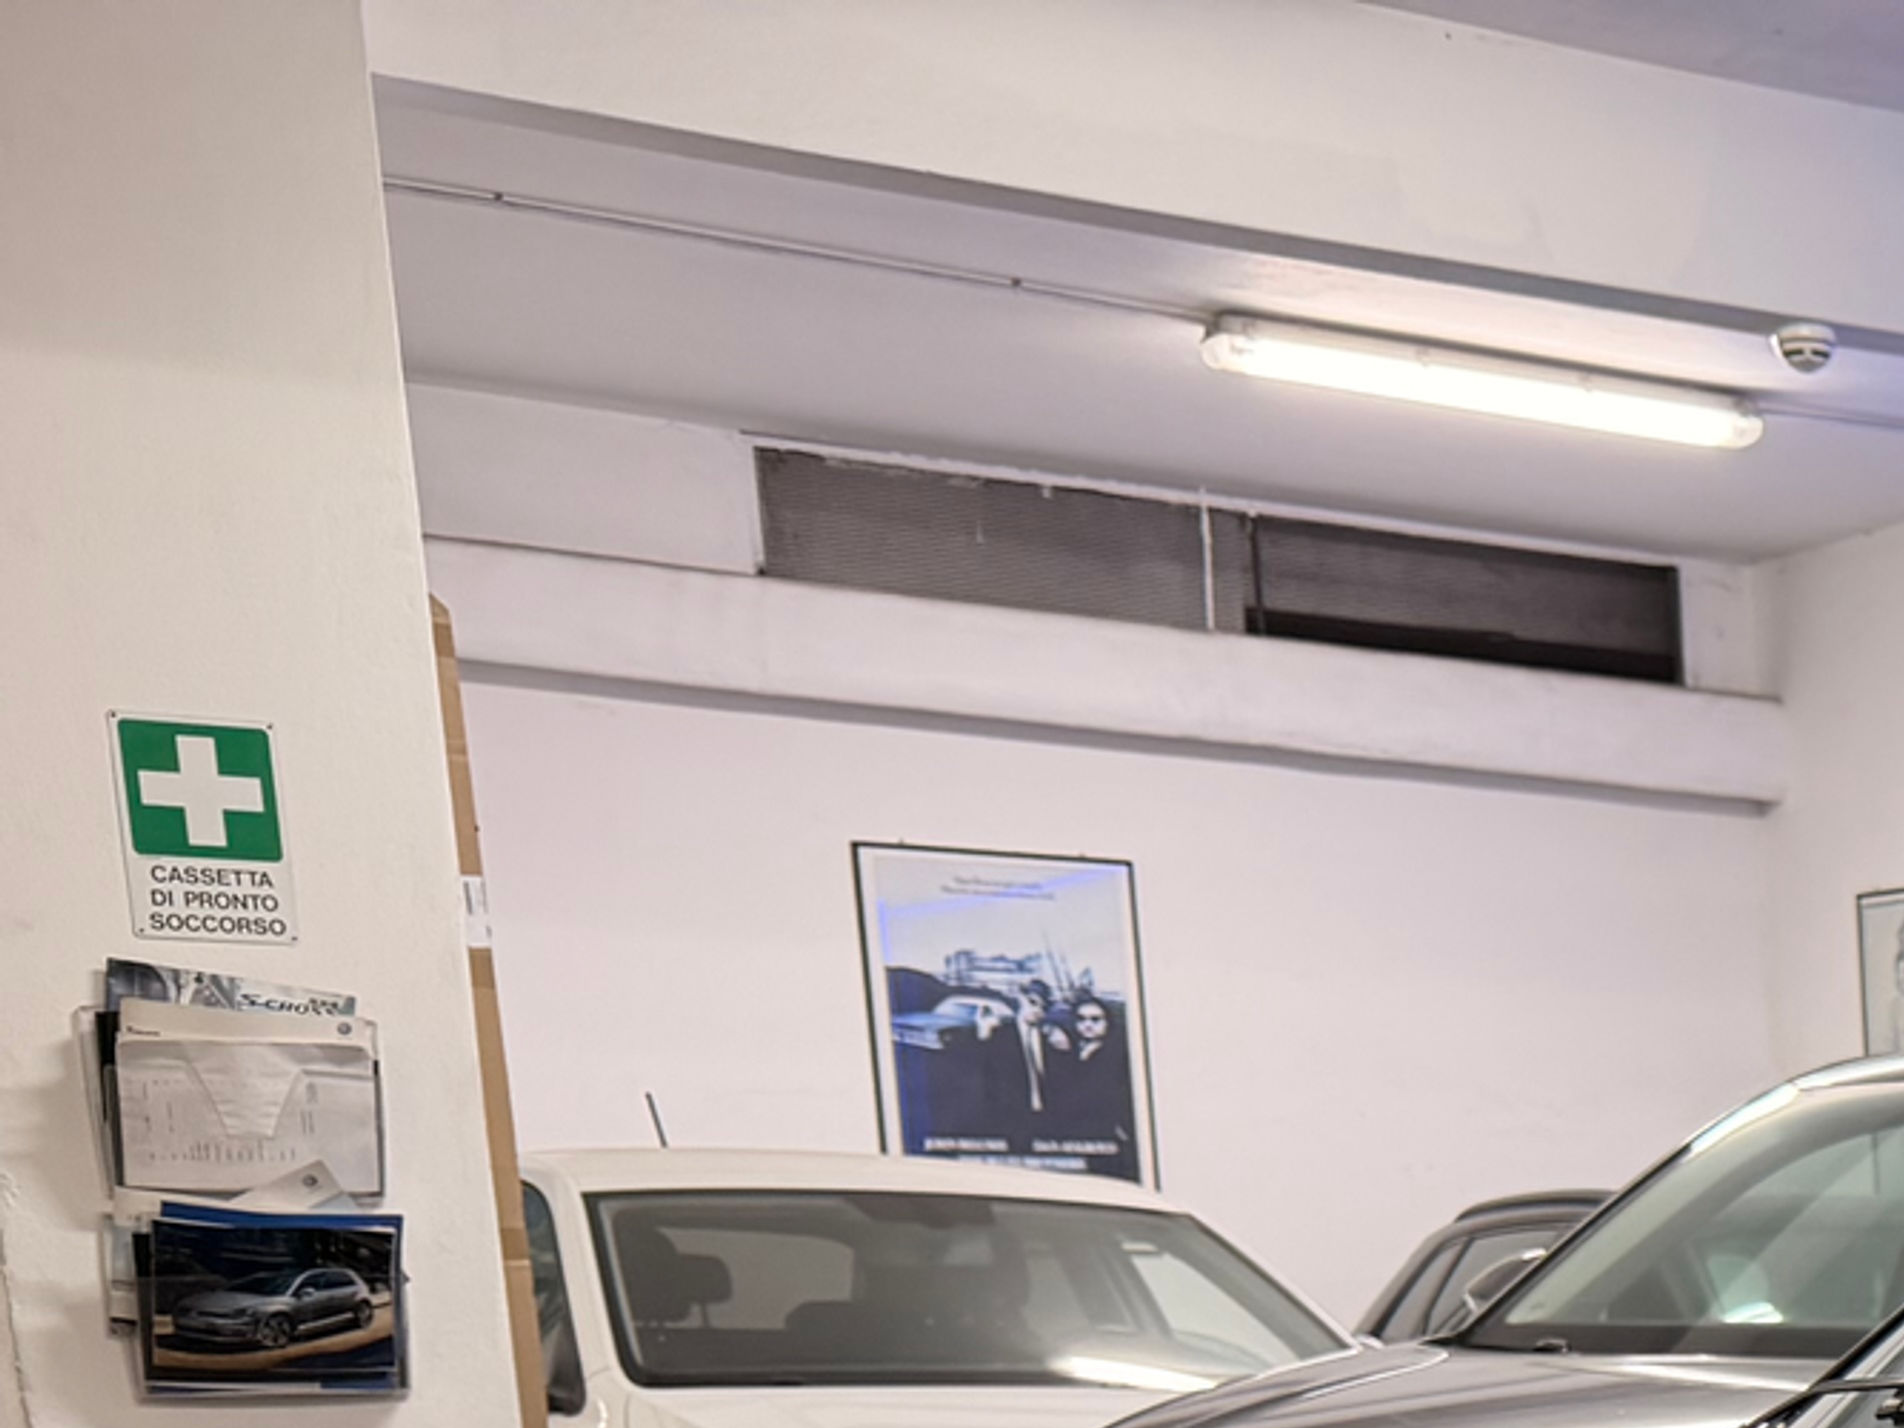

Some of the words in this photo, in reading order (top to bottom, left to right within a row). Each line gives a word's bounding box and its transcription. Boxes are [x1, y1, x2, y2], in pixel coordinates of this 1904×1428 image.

[150, 864, 274, 888] CASSETTA
[151, 888, 174, 907] DI
[184, 890, 279, 912] PRONTO
[149, 911, 287, 936] SOCCORSO
